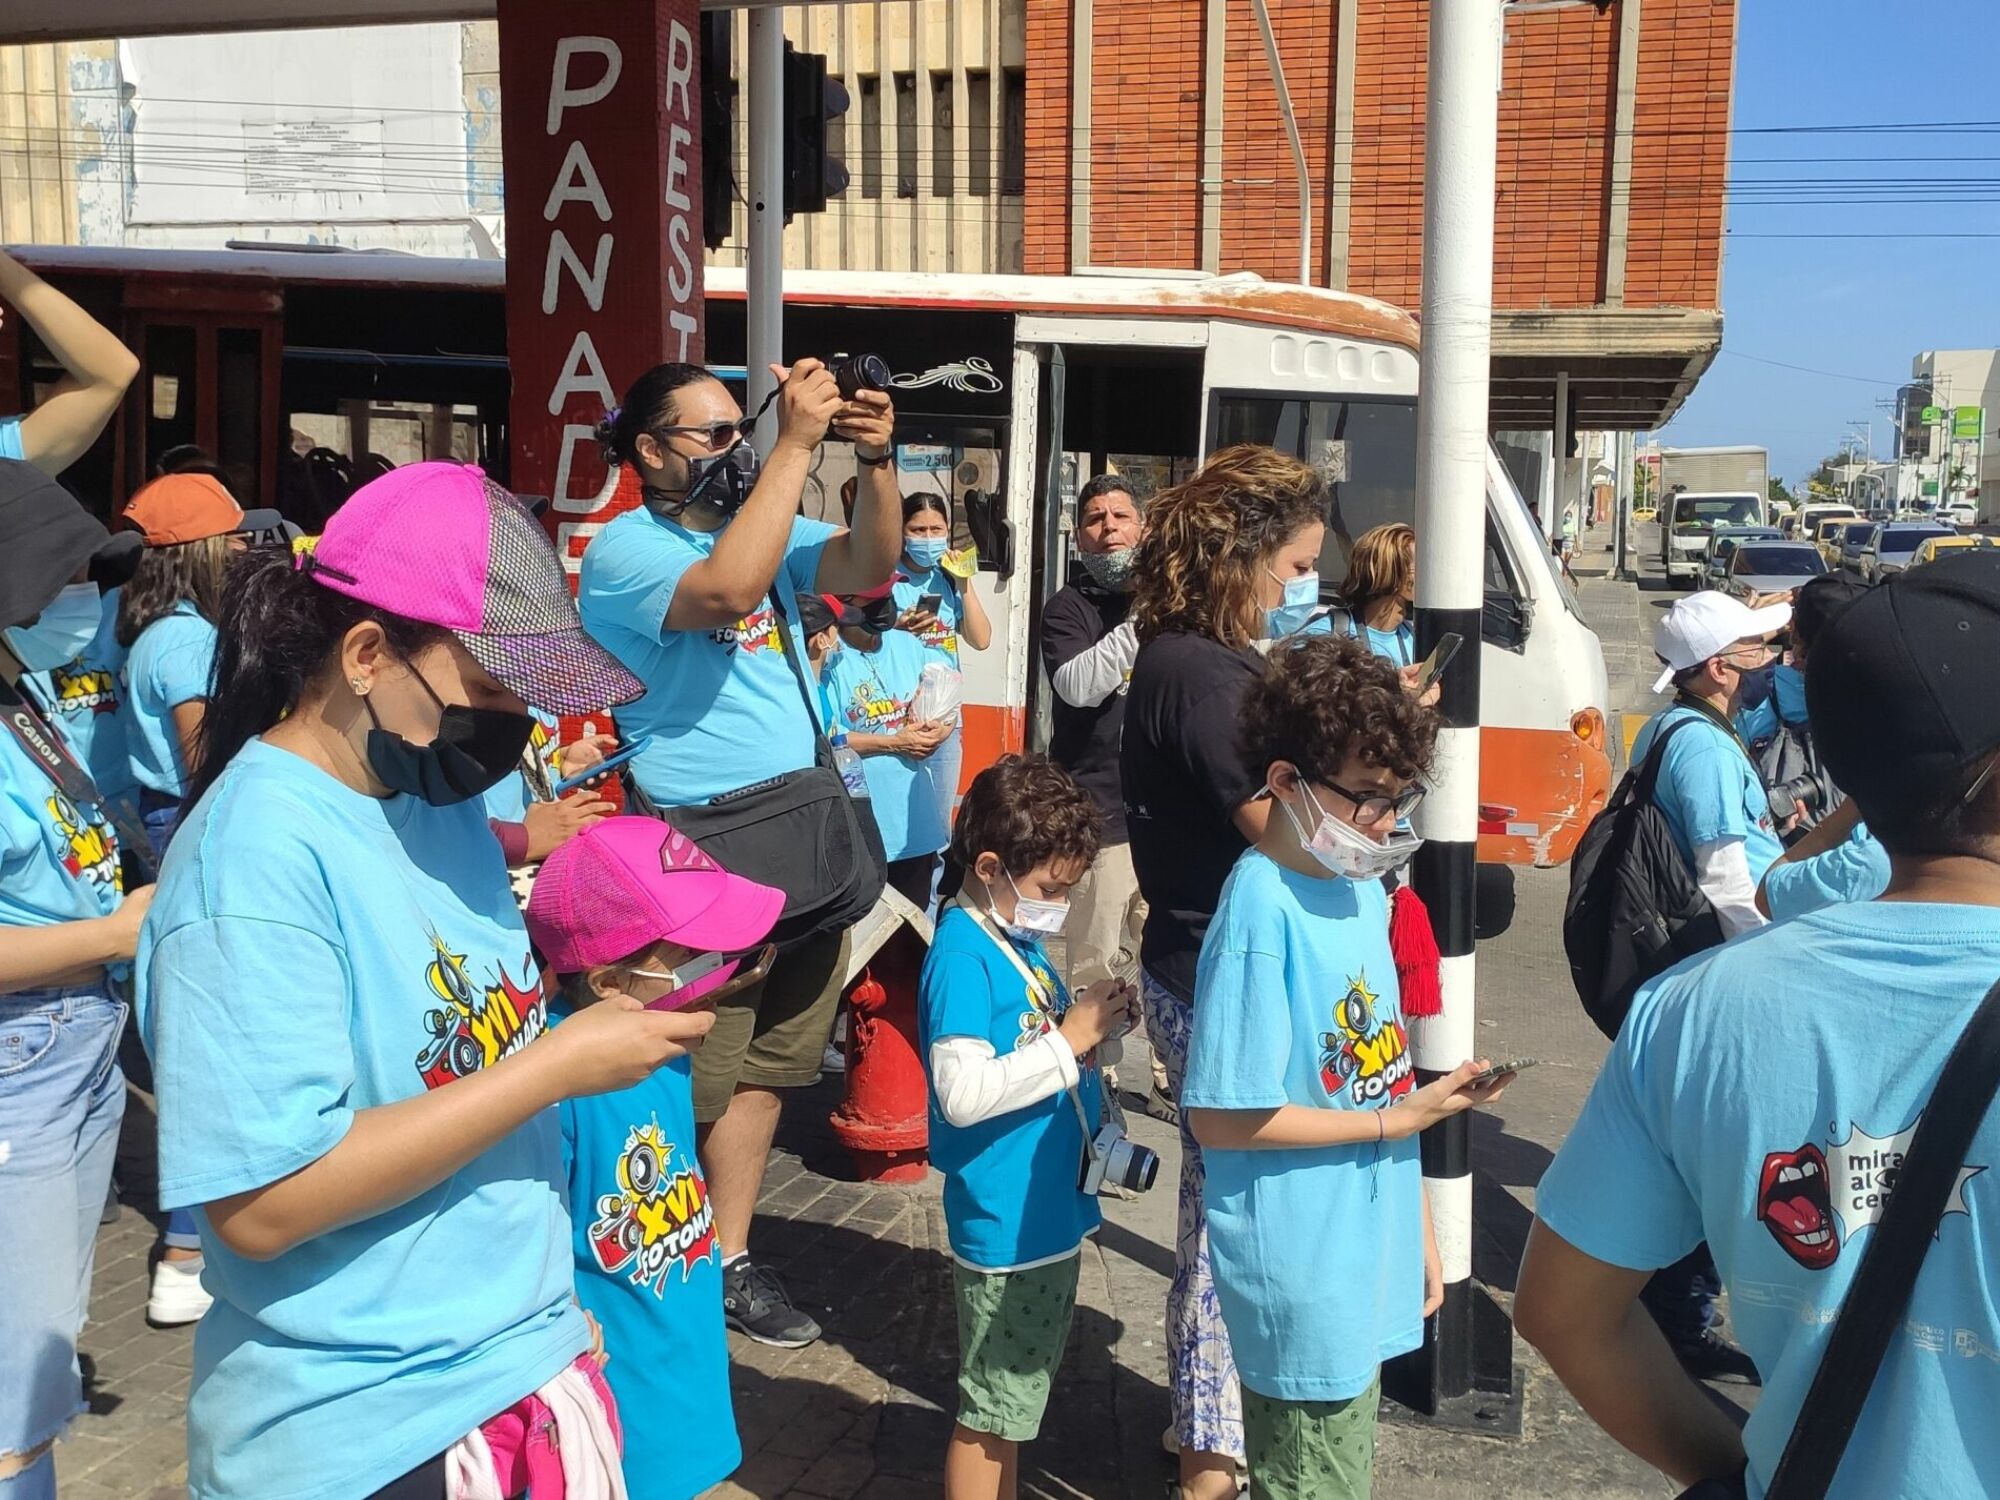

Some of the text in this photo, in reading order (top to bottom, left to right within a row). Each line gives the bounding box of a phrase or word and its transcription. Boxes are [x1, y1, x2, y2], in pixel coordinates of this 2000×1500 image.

[60, 671, 113, 698] XVI
[13, 711, 61, 767] Canon
[471, 987, 522, 1069] XVI
[1353, 1022, 1402, 1077] XVI
[1849, 1149, 1904, 1171] mira
[1851, 1172, 1873, 1191] al
[637, 1175, 702, 1246] XVI
